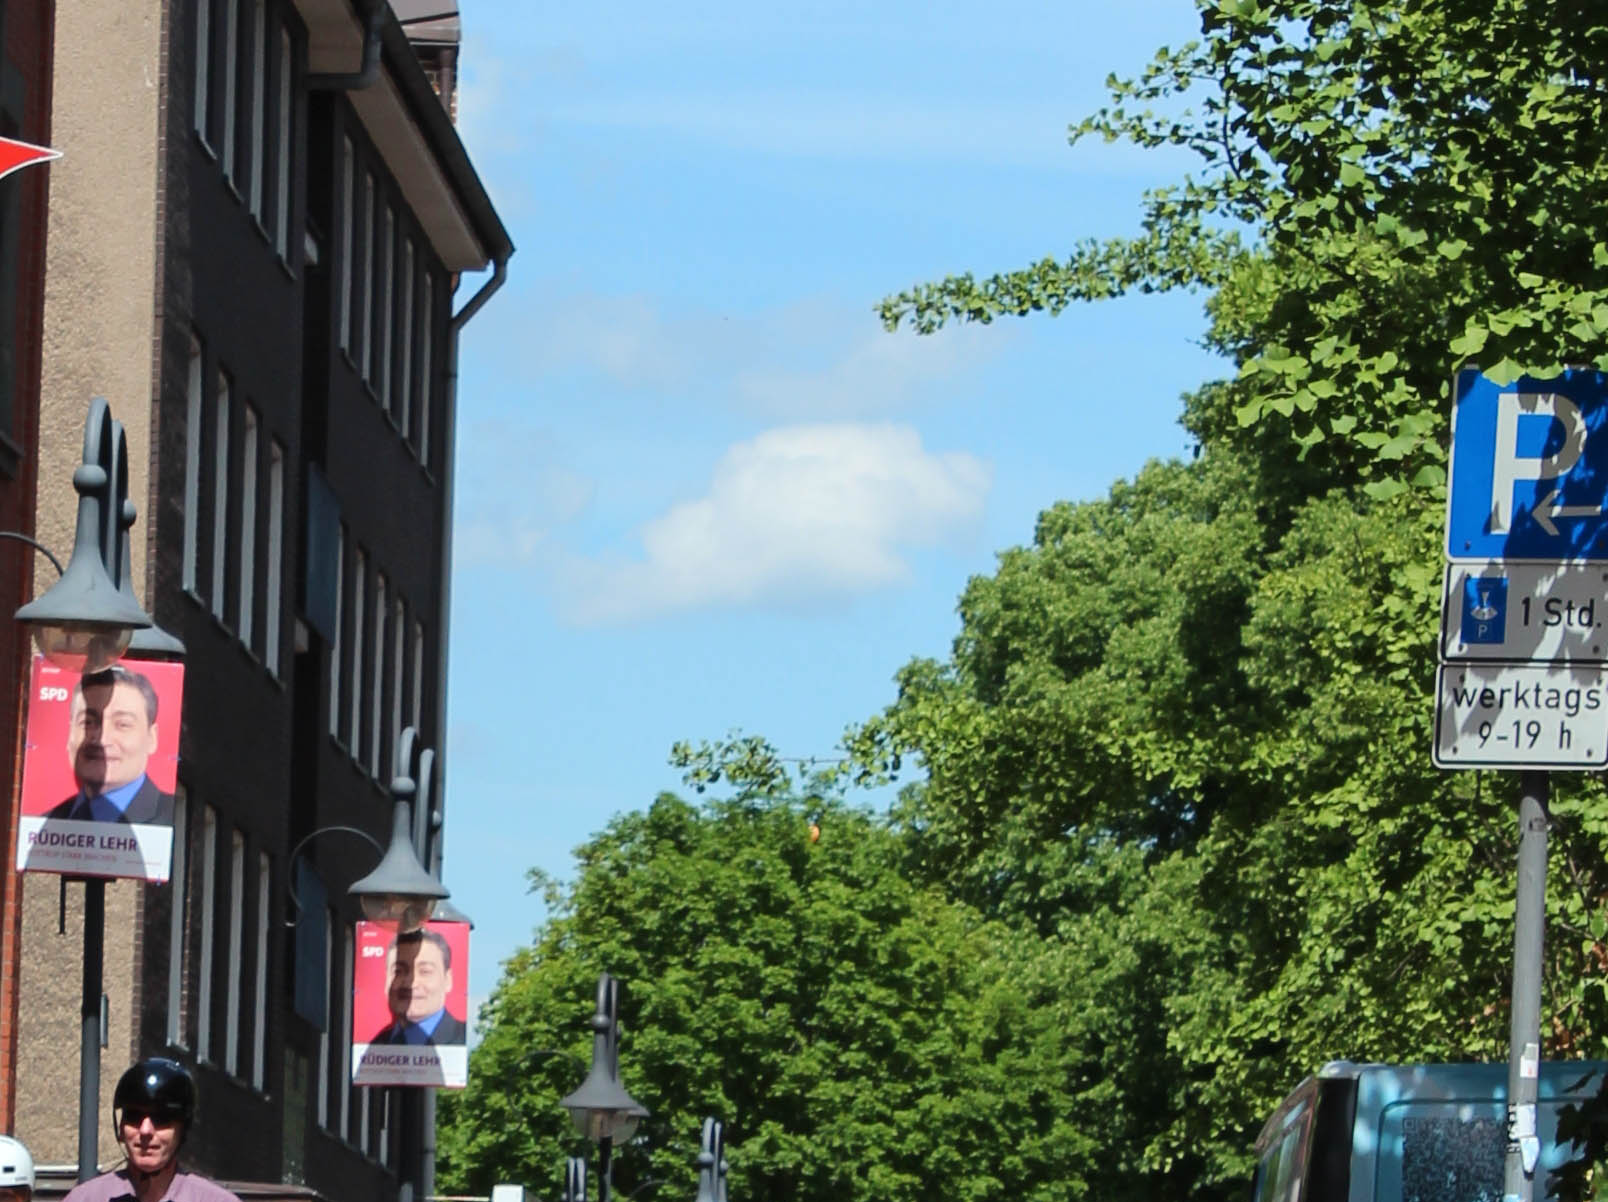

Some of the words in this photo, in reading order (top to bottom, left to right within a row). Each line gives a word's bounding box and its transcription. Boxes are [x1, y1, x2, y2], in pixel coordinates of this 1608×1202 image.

[1490, 392, 1587, 535] P
[1522, 597, 1530, 626] 1
[1543, 597, 1602, 627] Std.
[40, 686, 69, 702] SPD
[1452, 680, 1601, 718] werktags
[1479, 720, 1541, 749] 9-19
[1558, 720, 1571, 750] h
[28, 829, 95, 848] RÜDIGER
[99, 833, 137, 851] LEHR
[362, 946, 385, 958] SPD
[360, 1052, 409, 1067] RÜDIGER
